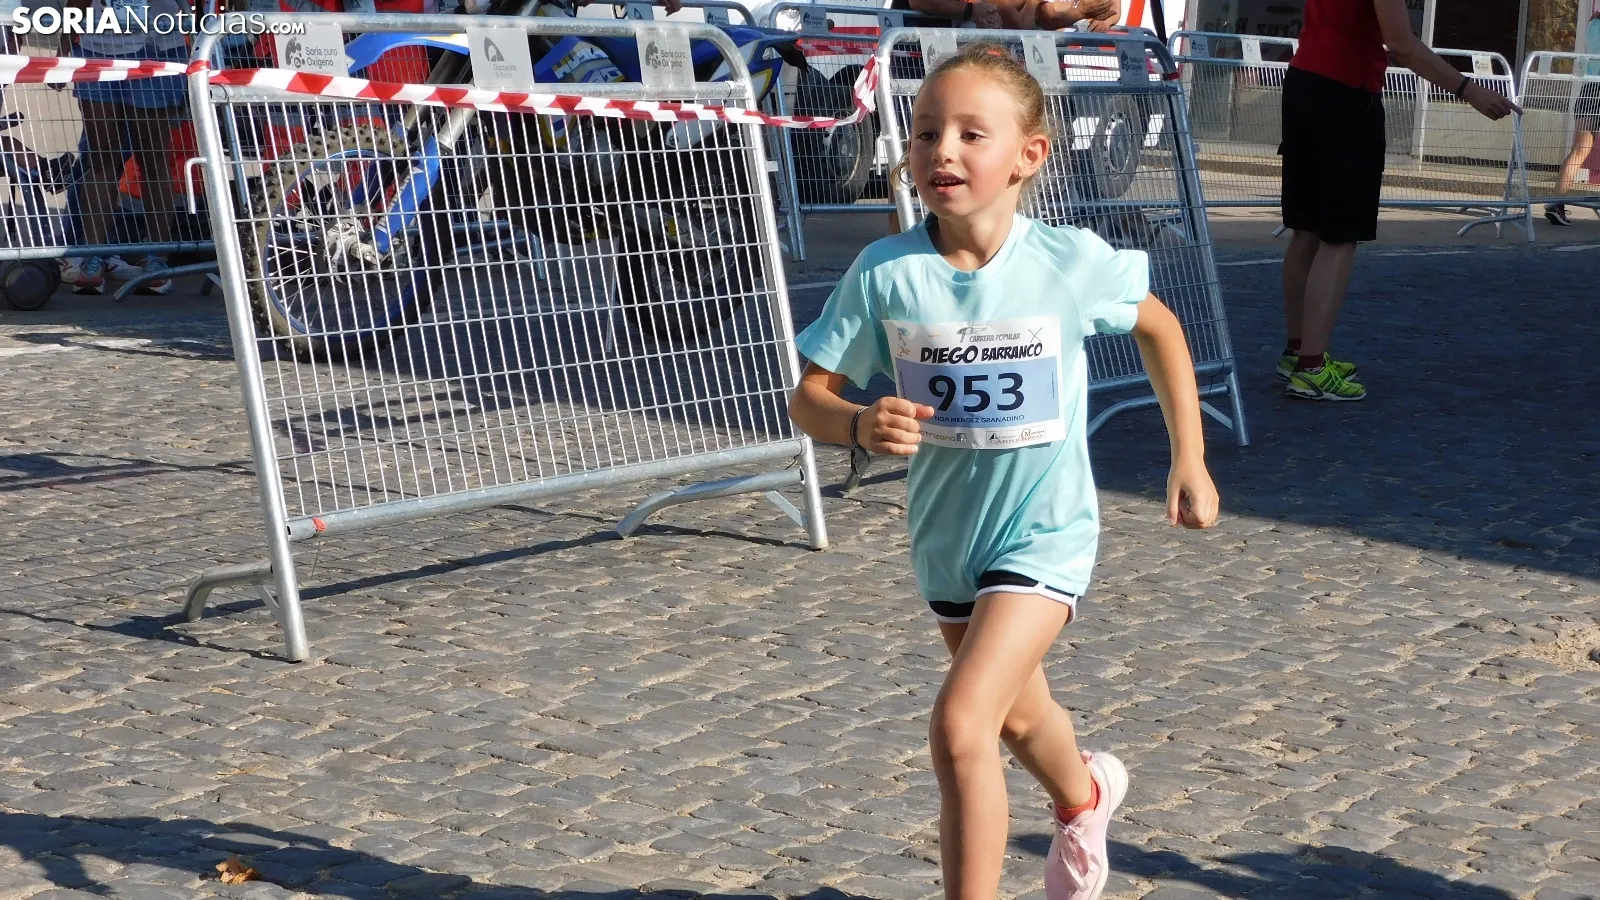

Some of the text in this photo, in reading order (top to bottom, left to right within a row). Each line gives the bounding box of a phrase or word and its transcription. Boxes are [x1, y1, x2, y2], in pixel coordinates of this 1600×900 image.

[305, 45, 338, 58] Soria puro
[661, 49, 674, 57] Soria
[995, 333, 1021, 341] POPULAR
[920, 343, 1043, 364] DIEGO BARRANCO
[928, 373, 1025, 412] 953
[981, 414, 1025, 423] GRANADINO
